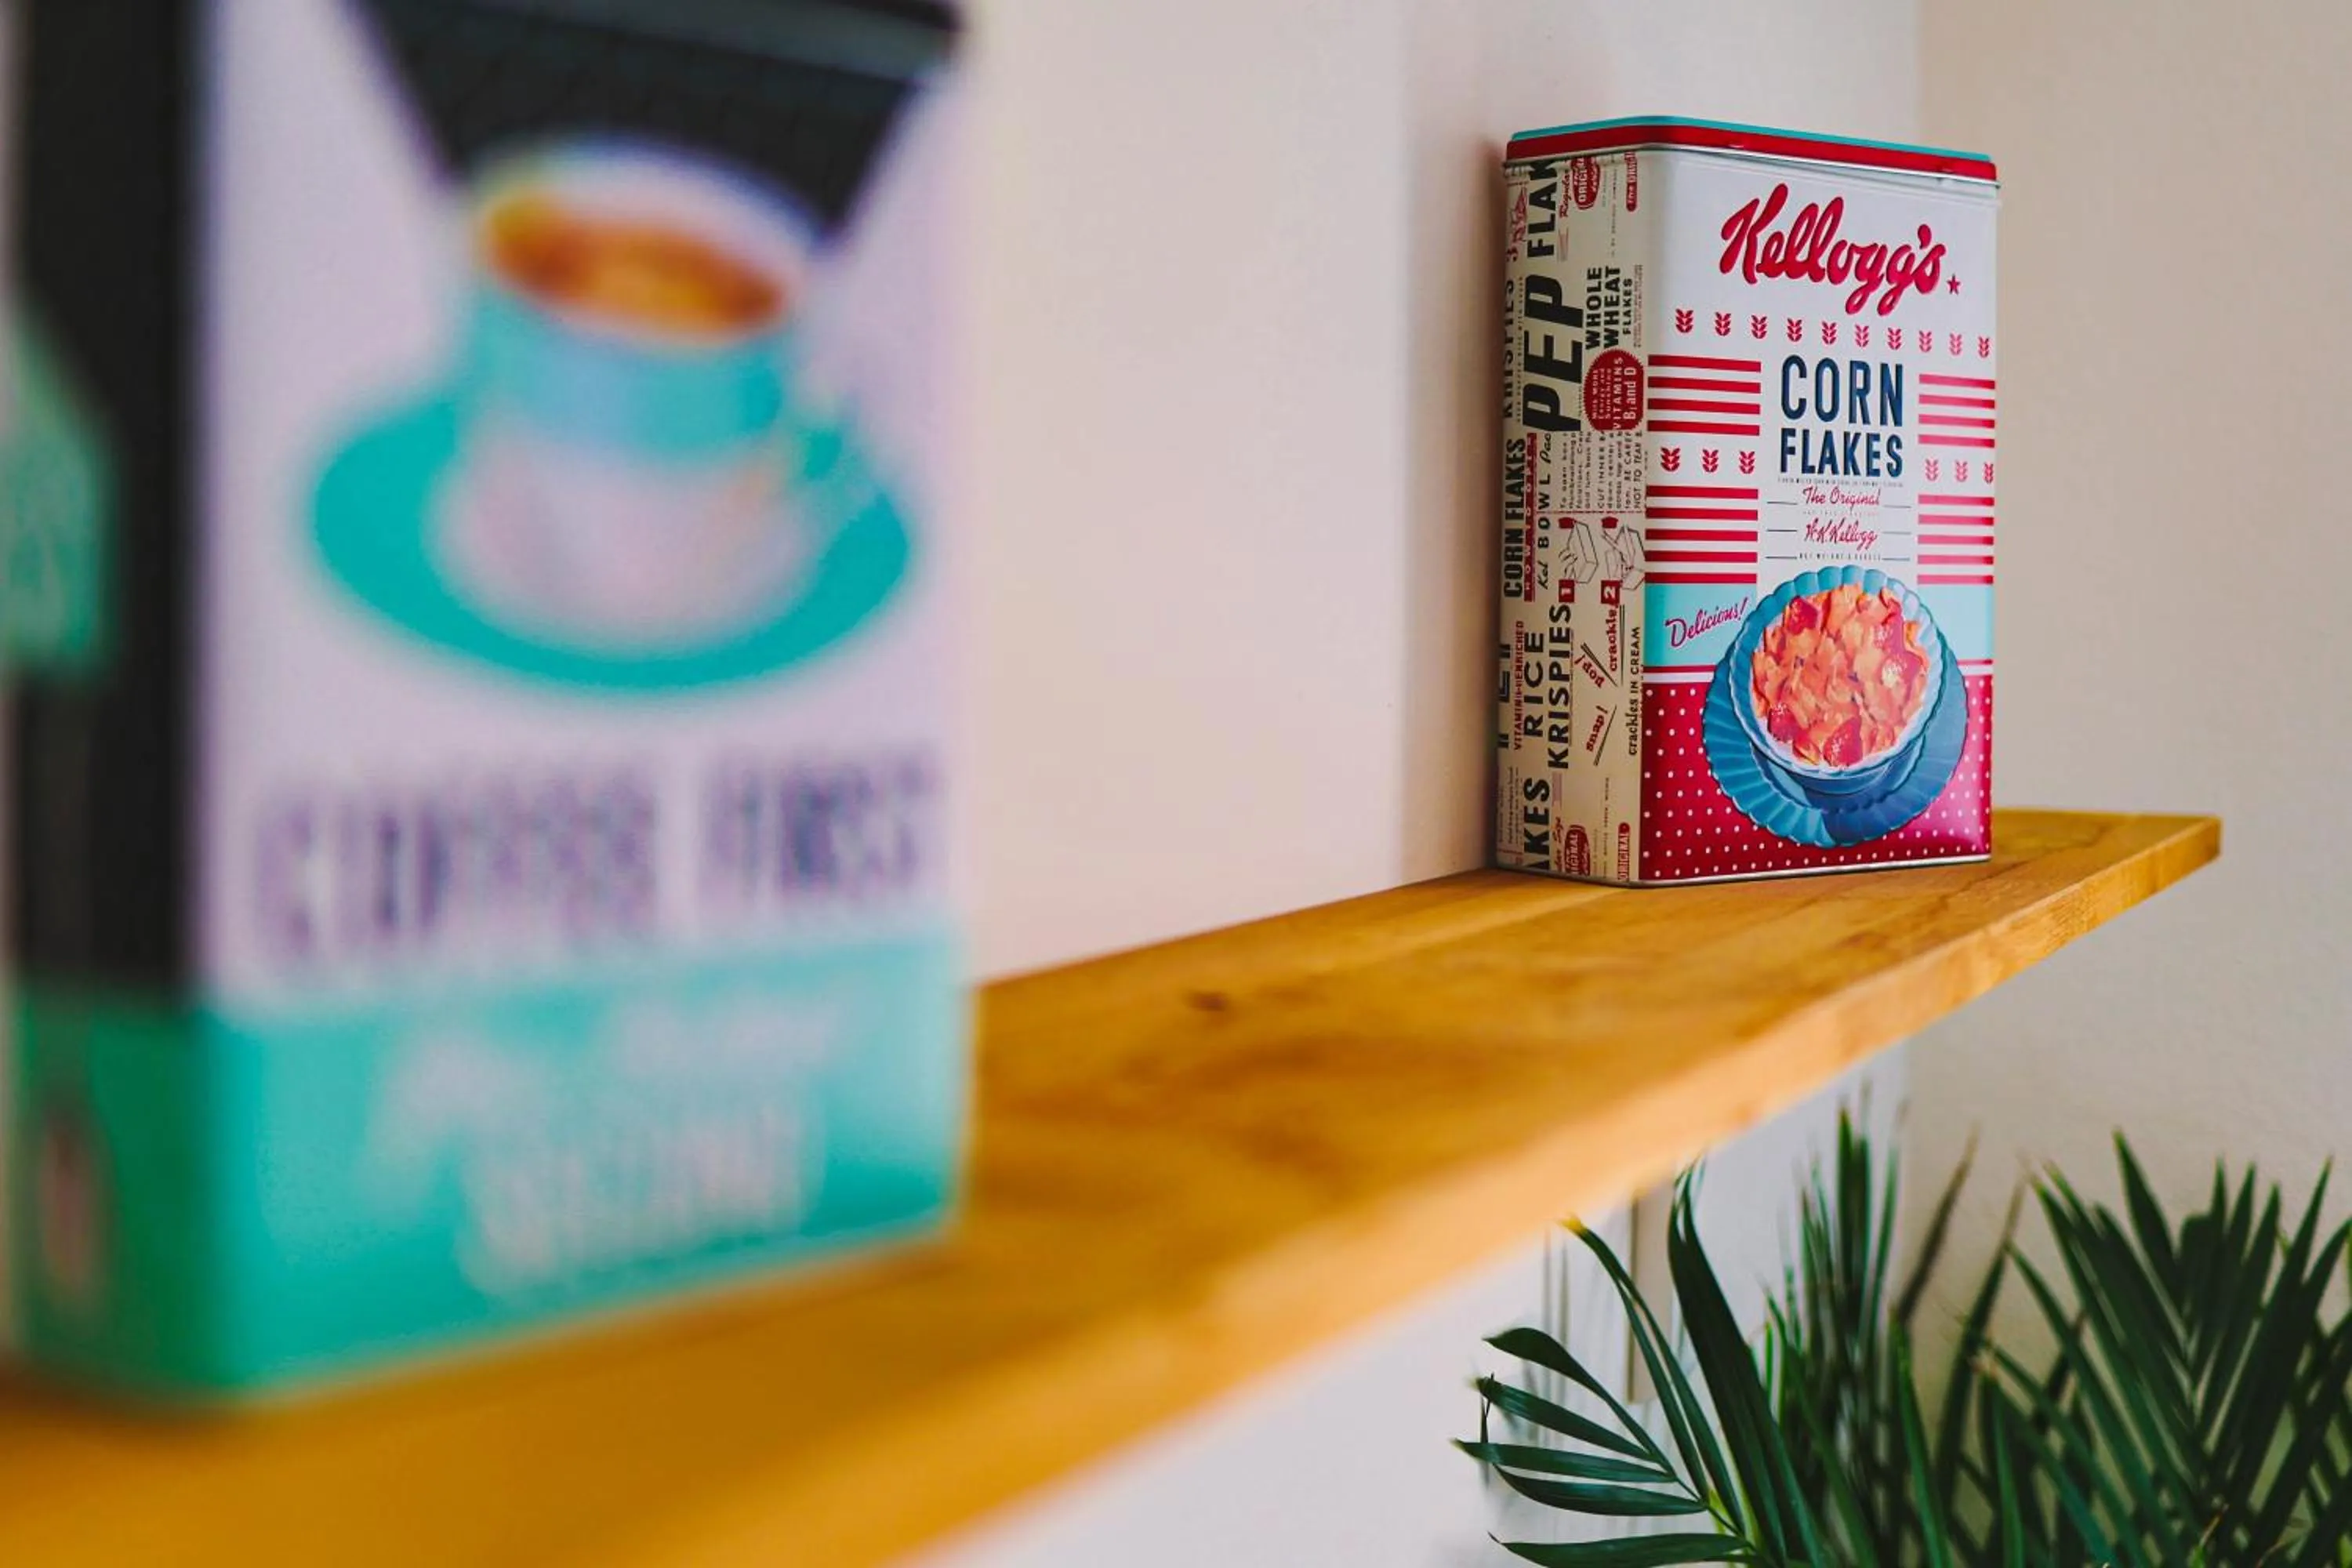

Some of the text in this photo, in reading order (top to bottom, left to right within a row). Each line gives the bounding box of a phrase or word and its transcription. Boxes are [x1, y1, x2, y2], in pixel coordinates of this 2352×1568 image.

[1719, 183, 1947, 317] Kellogg's
[1585, 267, 1602, 350] WHOLE
[1604, 266, 1620, 348] WHEAT
[1623, 278, 1632, 335] FLAKES
[1523, 274, 1583, 431] PEP
[1613, 357, 1623, 428] VITAMINS
[1781, 354, 1904, 427] CORN
[1780, 427, 1903, 478] FLAKES
[1504, 439, 1525, 597] CORN FLAKES
[1537, 474, 1550, 548] BOWL
[1802, 485, 1881, 510] The Original
[1605, 605, 1618, 671] crackle
[1665, 597, 1748, 649] Delicious!
[1524, 632, 1544, 737] RICE
[1548, 604, 1570, 769] KRISPIES
[1624, 627, 1640, 756] crackles IN CREAM
[1585, 706, 1607, 752] snap!
